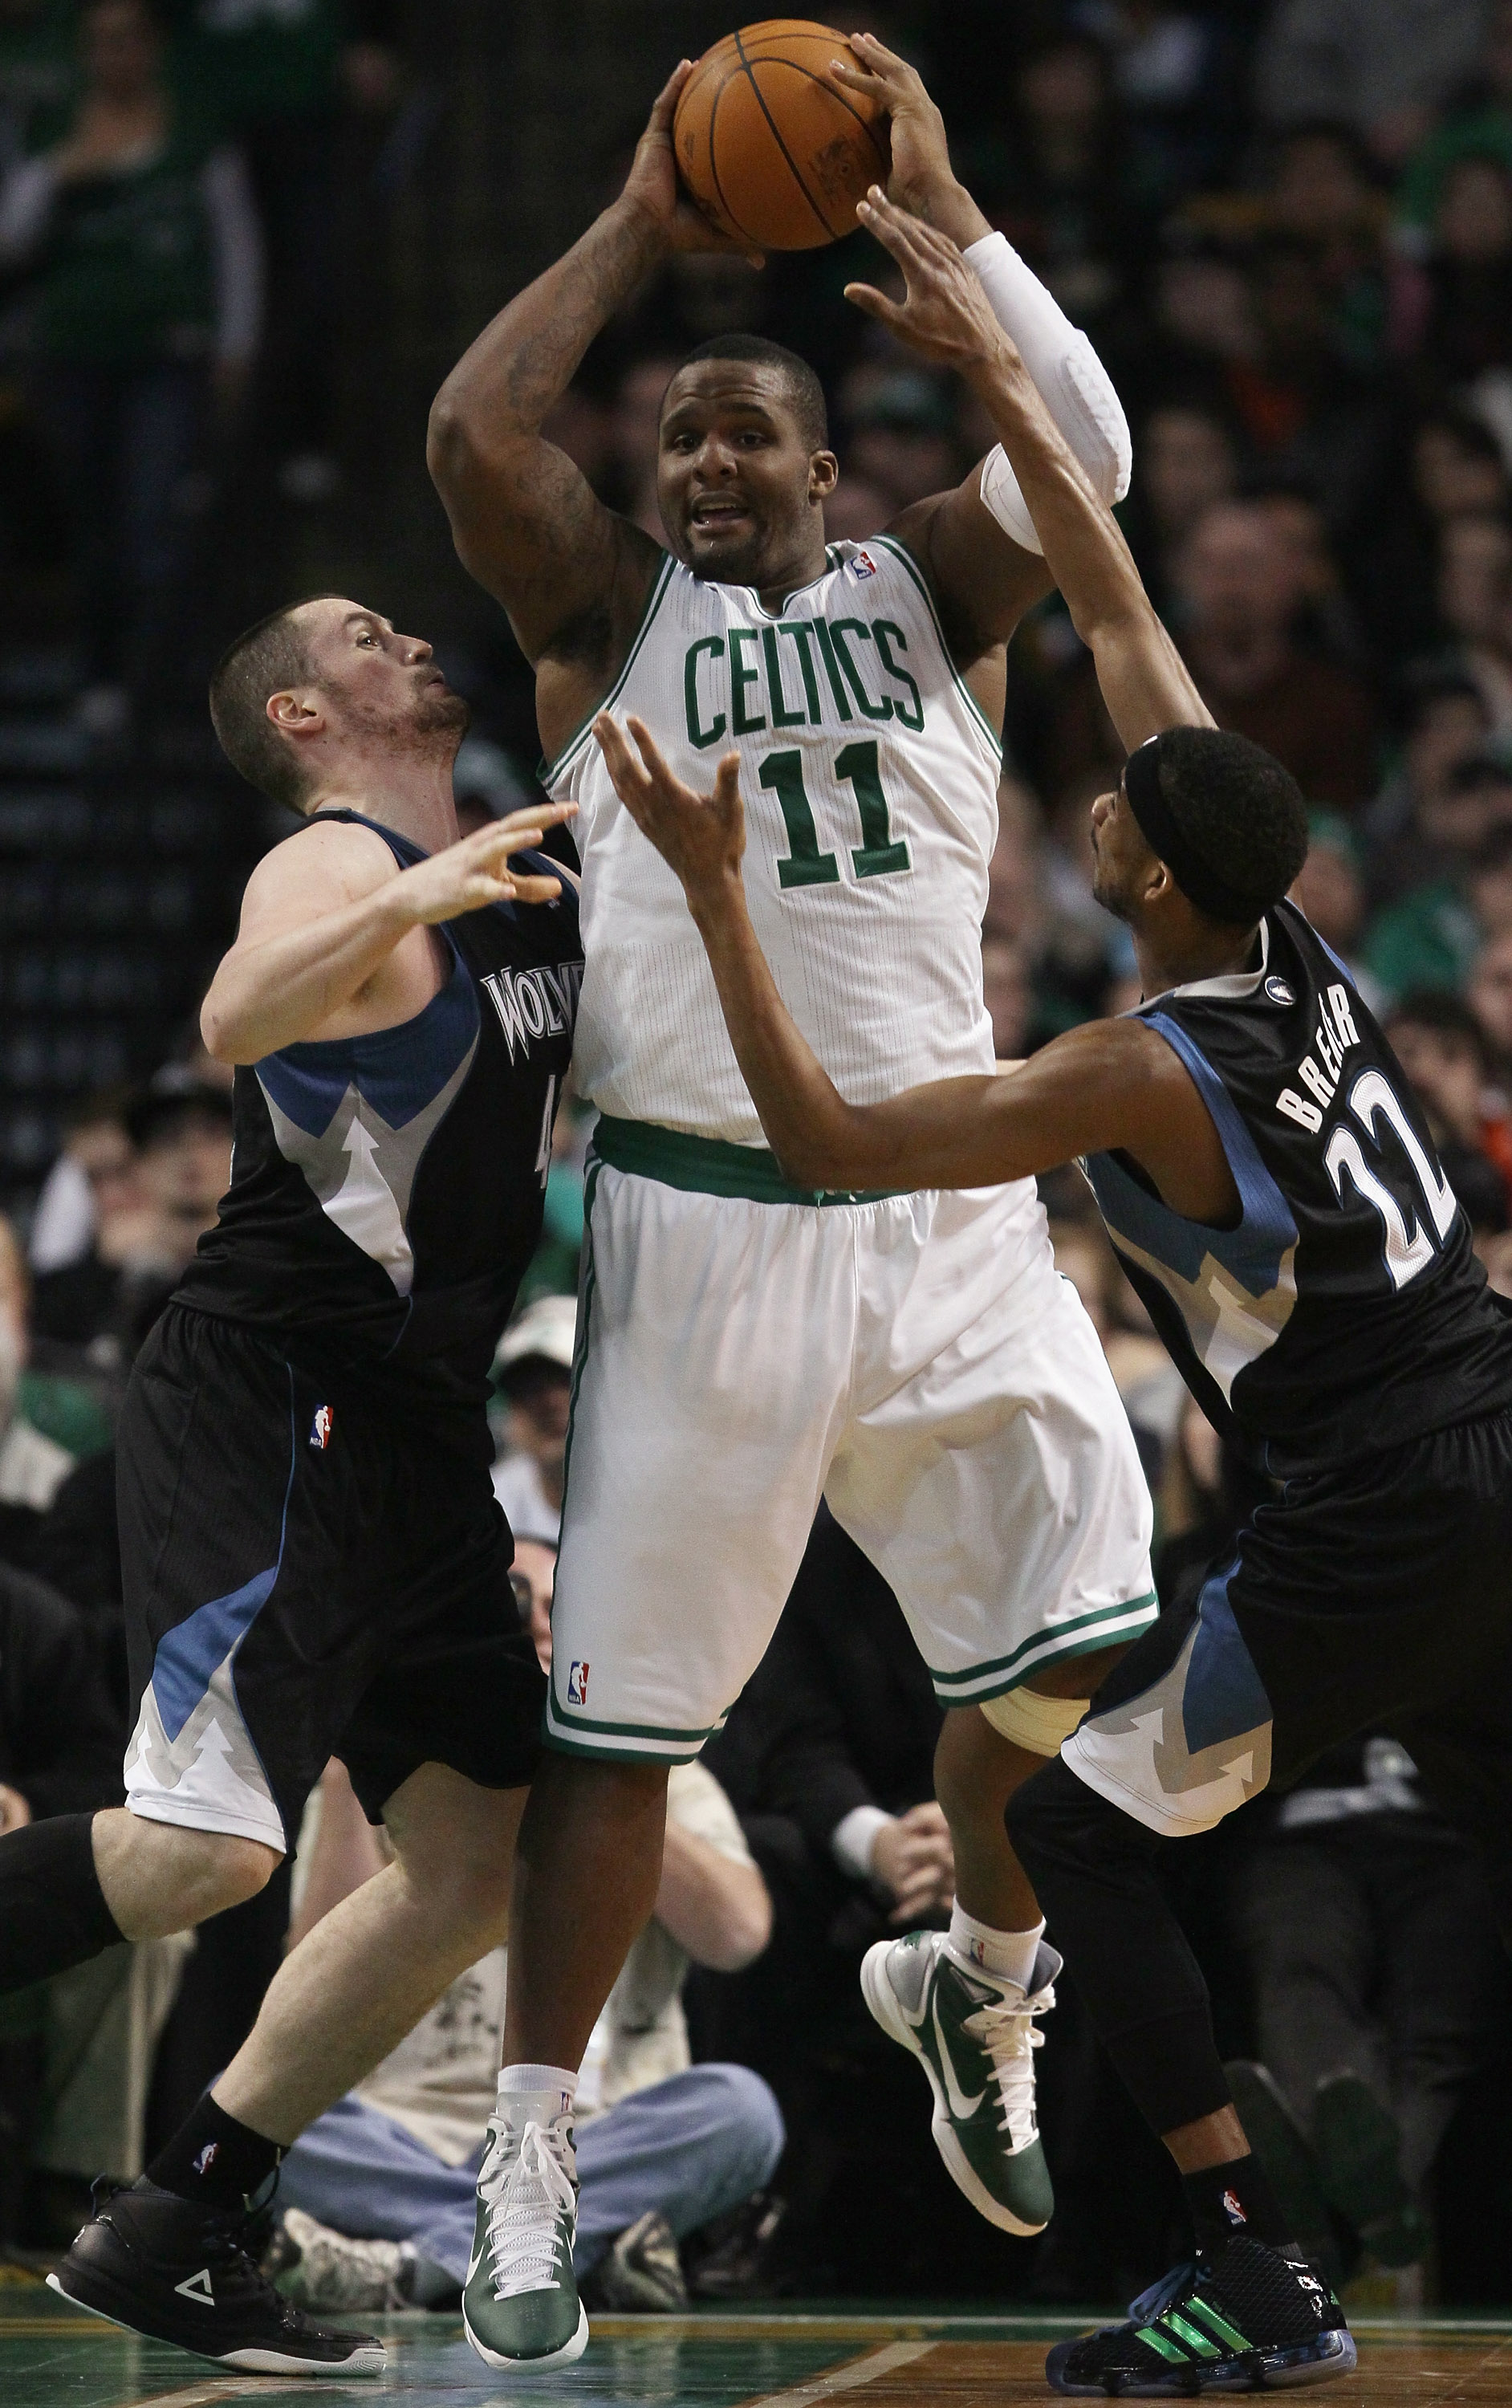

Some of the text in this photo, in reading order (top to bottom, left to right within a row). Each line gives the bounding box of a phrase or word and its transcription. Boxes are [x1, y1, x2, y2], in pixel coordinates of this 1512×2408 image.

[685, 616, 925, 750] CELTICS
[757, 739, 912, 890] 11
[1324, 1068, 1457, 1291] 22
